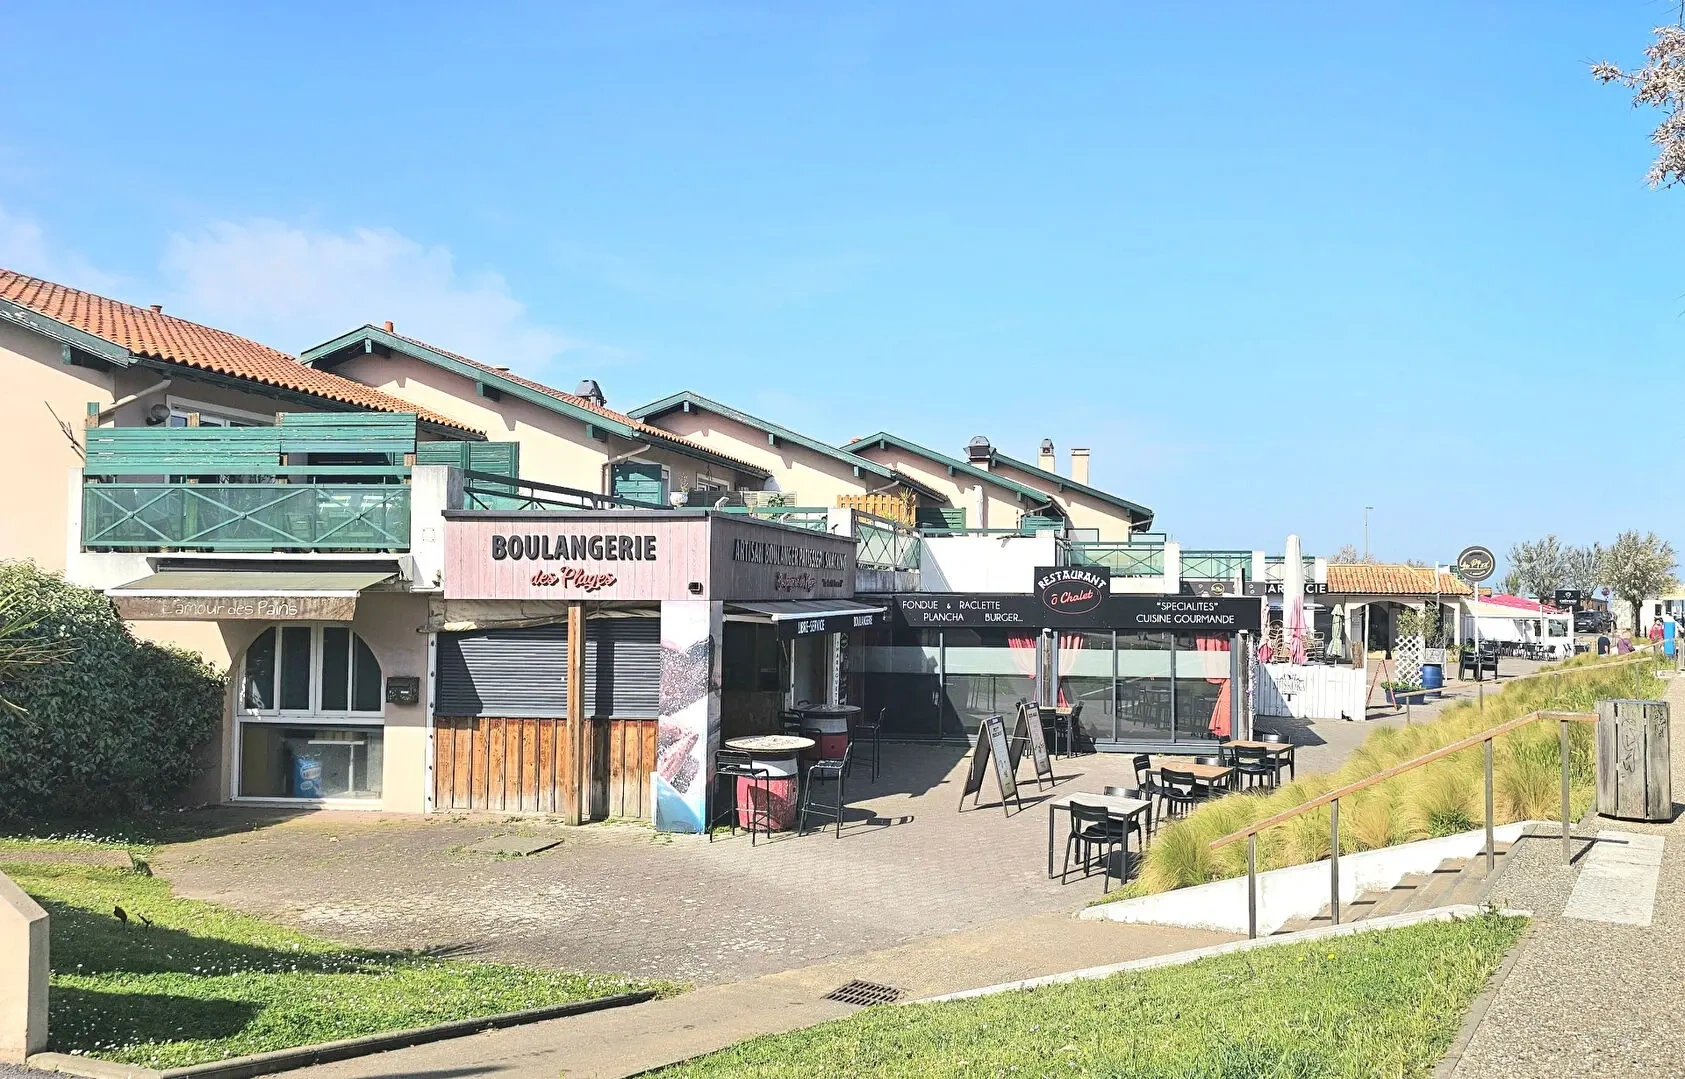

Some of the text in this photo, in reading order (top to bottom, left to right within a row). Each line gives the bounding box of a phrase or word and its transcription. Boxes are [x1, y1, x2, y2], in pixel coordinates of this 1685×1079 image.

[492, 535, 657, 561] BOULANGERIE
[733, 538, 763, 564] ARTISAN
[531, 566, 618, 593] des Plages
[1037, 569, 1107, 590] RESTAURANT
[1060, 589, 1094, 604] Chalet
[227, 600, 254, 615] des
[257, 600, 298, 615] Pains
[902, 600, 939, 610] FONDUE
[959, 600, 1001, 610] RACLETTE
[923, 612, 964, 622] PLANCHA
[1136, 614, 1235, 624] CUISINE GOURMANDE
